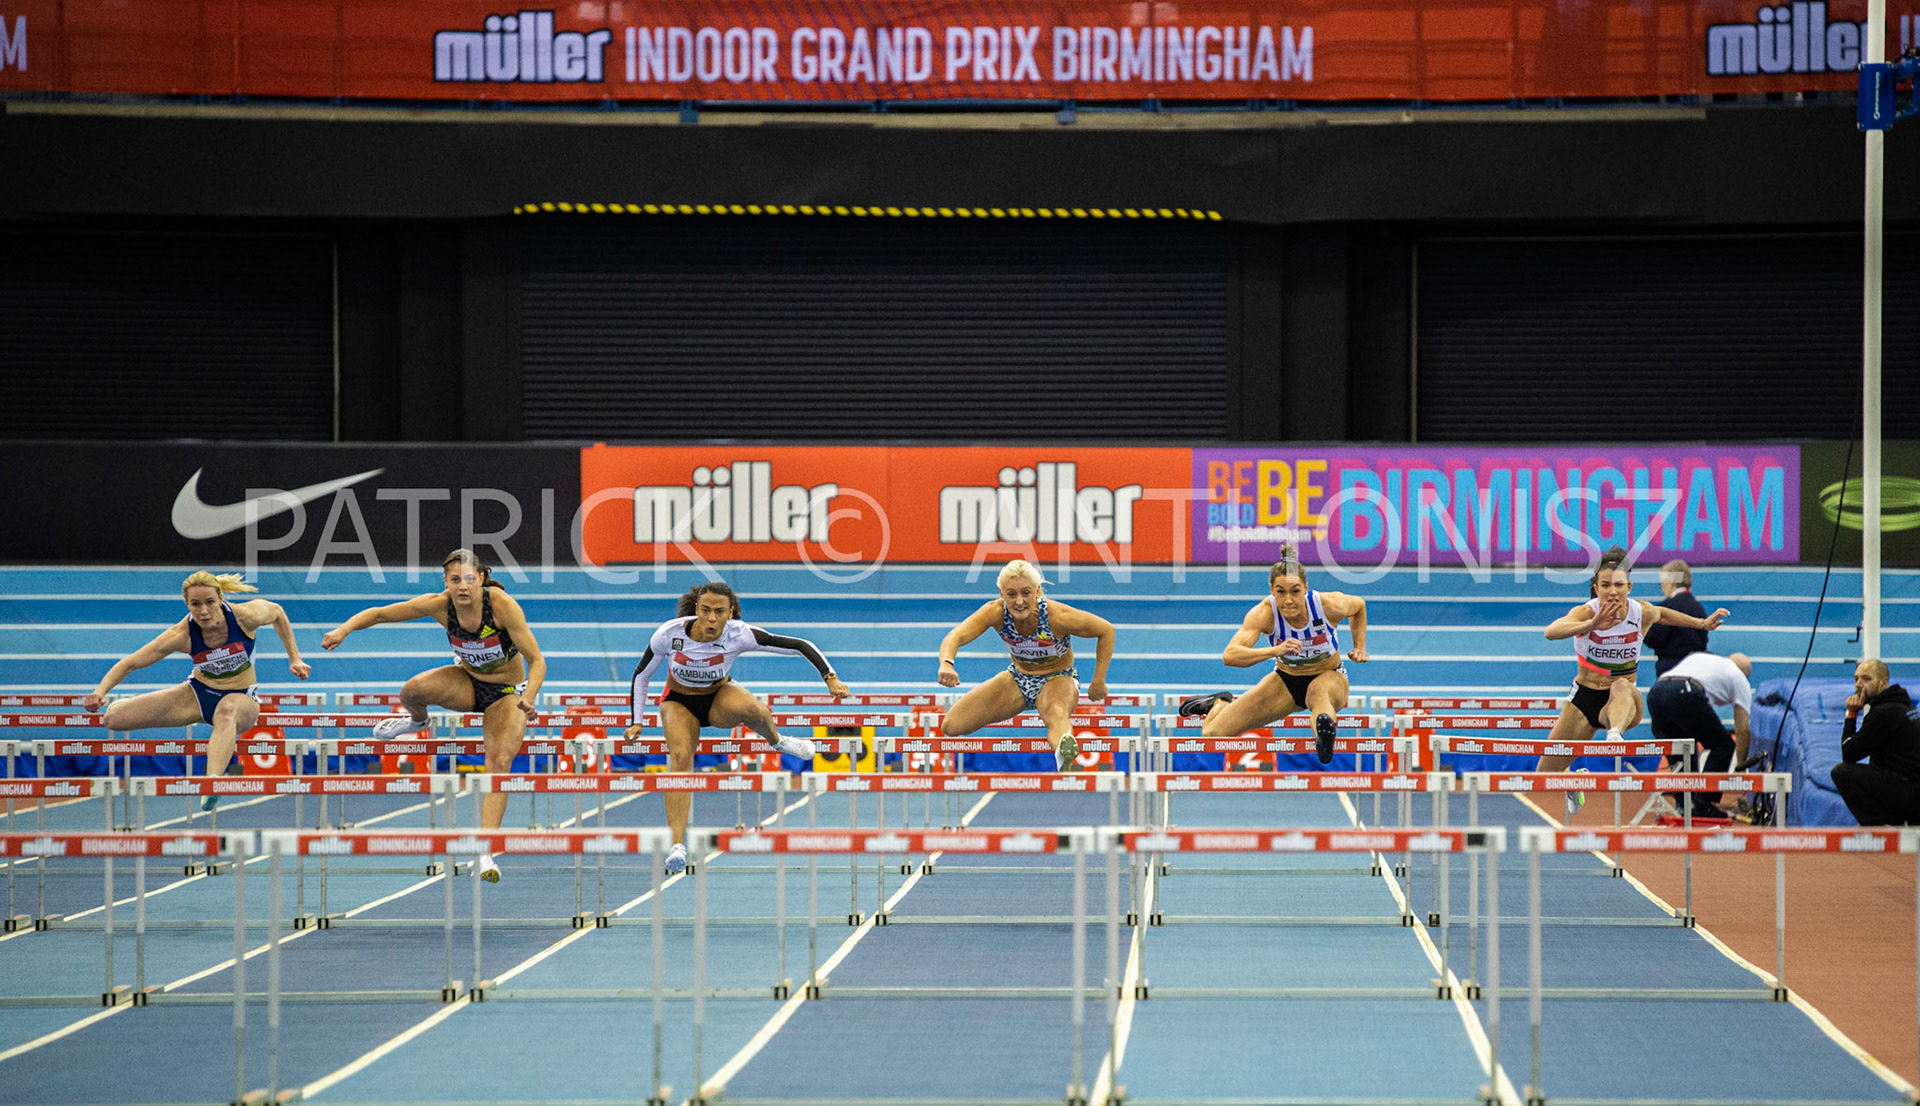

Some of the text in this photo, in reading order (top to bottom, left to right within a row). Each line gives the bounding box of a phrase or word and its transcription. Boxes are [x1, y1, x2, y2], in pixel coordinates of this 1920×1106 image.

[434, 10, 612, 83] müller
[625, 26, 1314, 82] INDOOR GRAND PRIX BIRMINGHAM
[1208, 461, 1254, 503] BE
[633, 461, 838, 543] müller
[940, 462, 1143, 543] müller
[1257, 460, 1785, 551] BE BIRMINGHAM
[1207, 504, 1255, 525] BOLD
[1011, 647, 1049, 657] LAVIN
[1588, 645, 1636, 659] KEREKES
[62, 741, 93, 754] müller
[102, 743, 145, 753] BIRMINGHAM
[155, 741, 185, 754] müller
[247, 742, 277, 755] müller
[345, 742, 375, 755] müller
[384, 744, 427, 754] BIRMINGHAM
[436, 742, 466, 754] müller
[527, 742, 557, 754] müller
[712, 742, 741, 754] müller
[902, 740, 932, 752] müller
[941, 741, 983, 751] BIRMINGHAM
[992, 740, 1021, 752] müller
[1082, 740, 1111, 752] müller
[1176, 740, 1206, 752] müller
[1215, 741, 1257, 751] BIRMINGHAM
[1266, 740, 1295, 752] müller
[1356, 740, 1386, 752] müller
[1456, 740, 1665, 756] müller BIRMINGHAM müller BIRMINGHAM müller
[44, 782, 81, 797] müller
[165, 778, 421, 794] müller BIRMINGHAM müller BIRMINGHAM müller
[500, 776, 753, 792] müller BIRMINGHAM müller BIRMINGHAM müller
[835, 776, 1087, 791] müller BIRMINGHAM müller BIRMINGHAM müller
[1165, 775, 1418, 791] müller BIRMINGHAM müller BIRMINGHAM müller
[1498, 776, 1754, 791] müller BIRMINGHAM müller BIRMINGHAM müller
